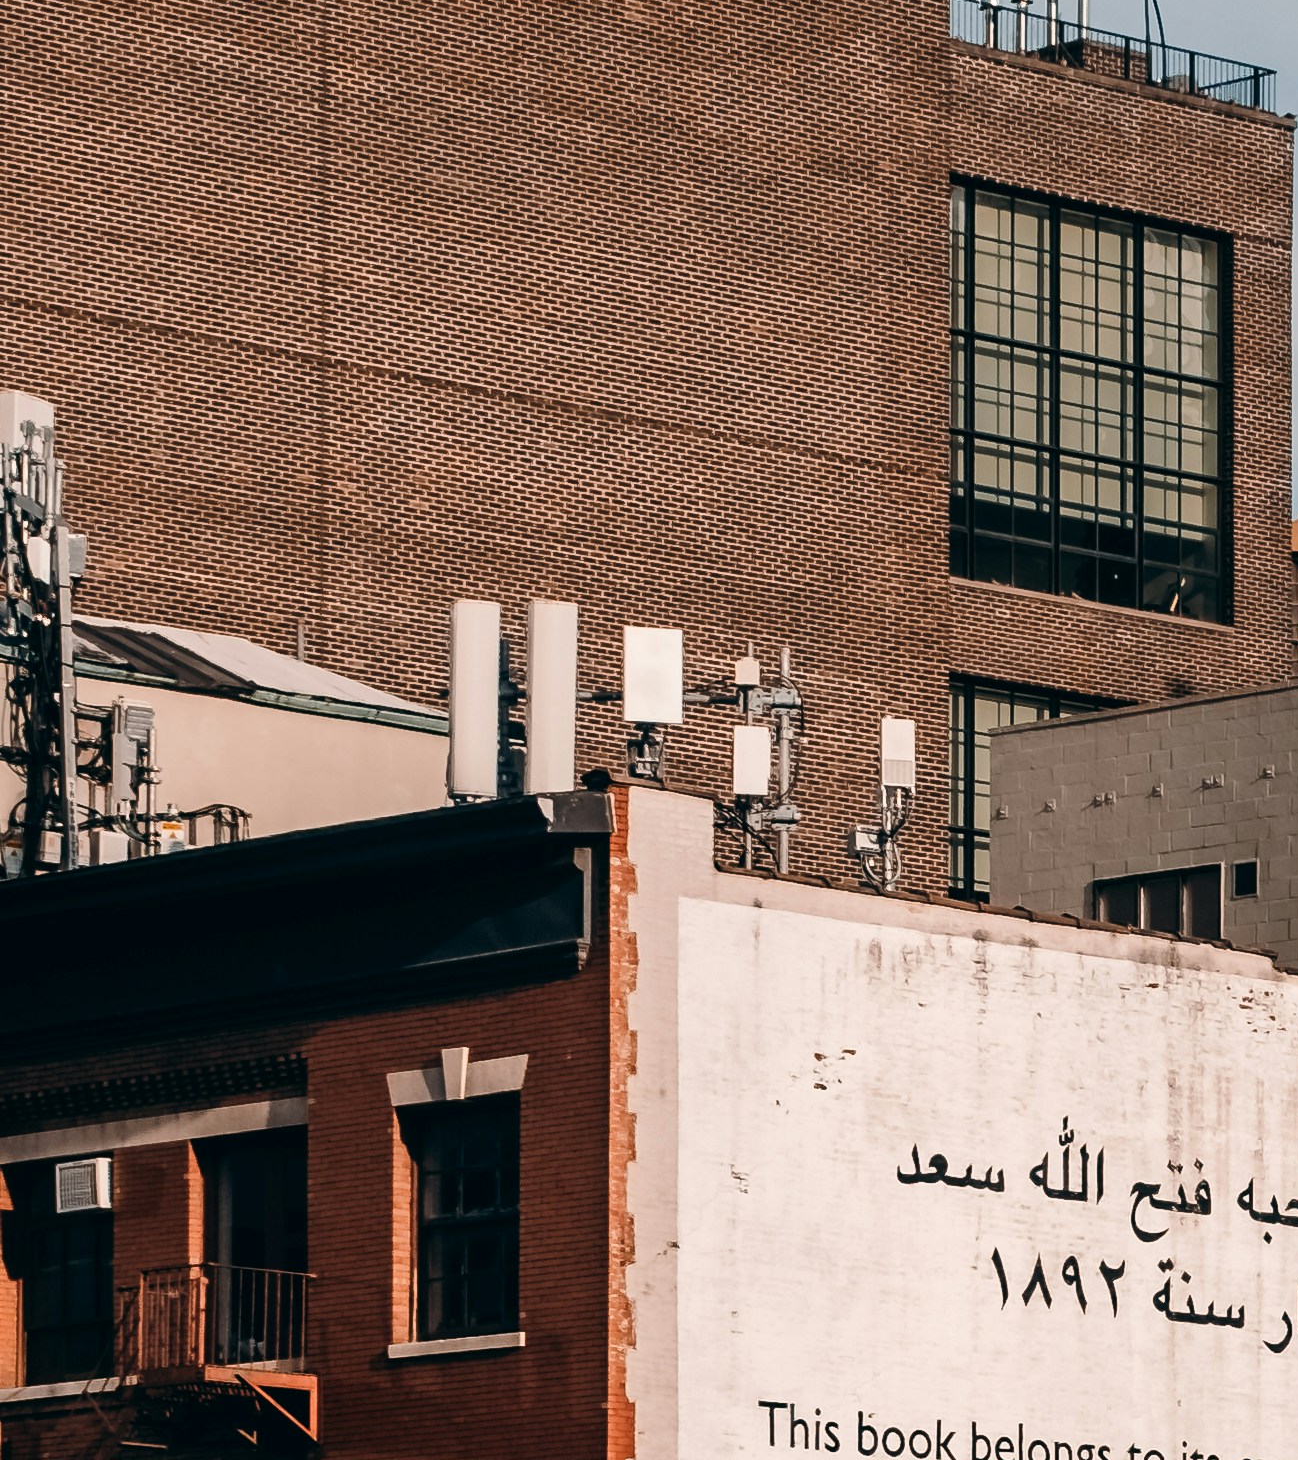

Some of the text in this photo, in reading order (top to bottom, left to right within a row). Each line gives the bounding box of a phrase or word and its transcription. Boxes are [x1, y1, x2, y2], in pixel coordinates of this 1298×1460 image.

[896, 1143, 1005, 1193] سعد
[1129, 1158, 1212, 1243] فتح
[991, 1247, 1126, 1318] ١٨٩٢
[1152, 1258, 1245, 1329] سنة
[758, 1400, 841, 1453] This
[857, 1410, 957, 1460] book
